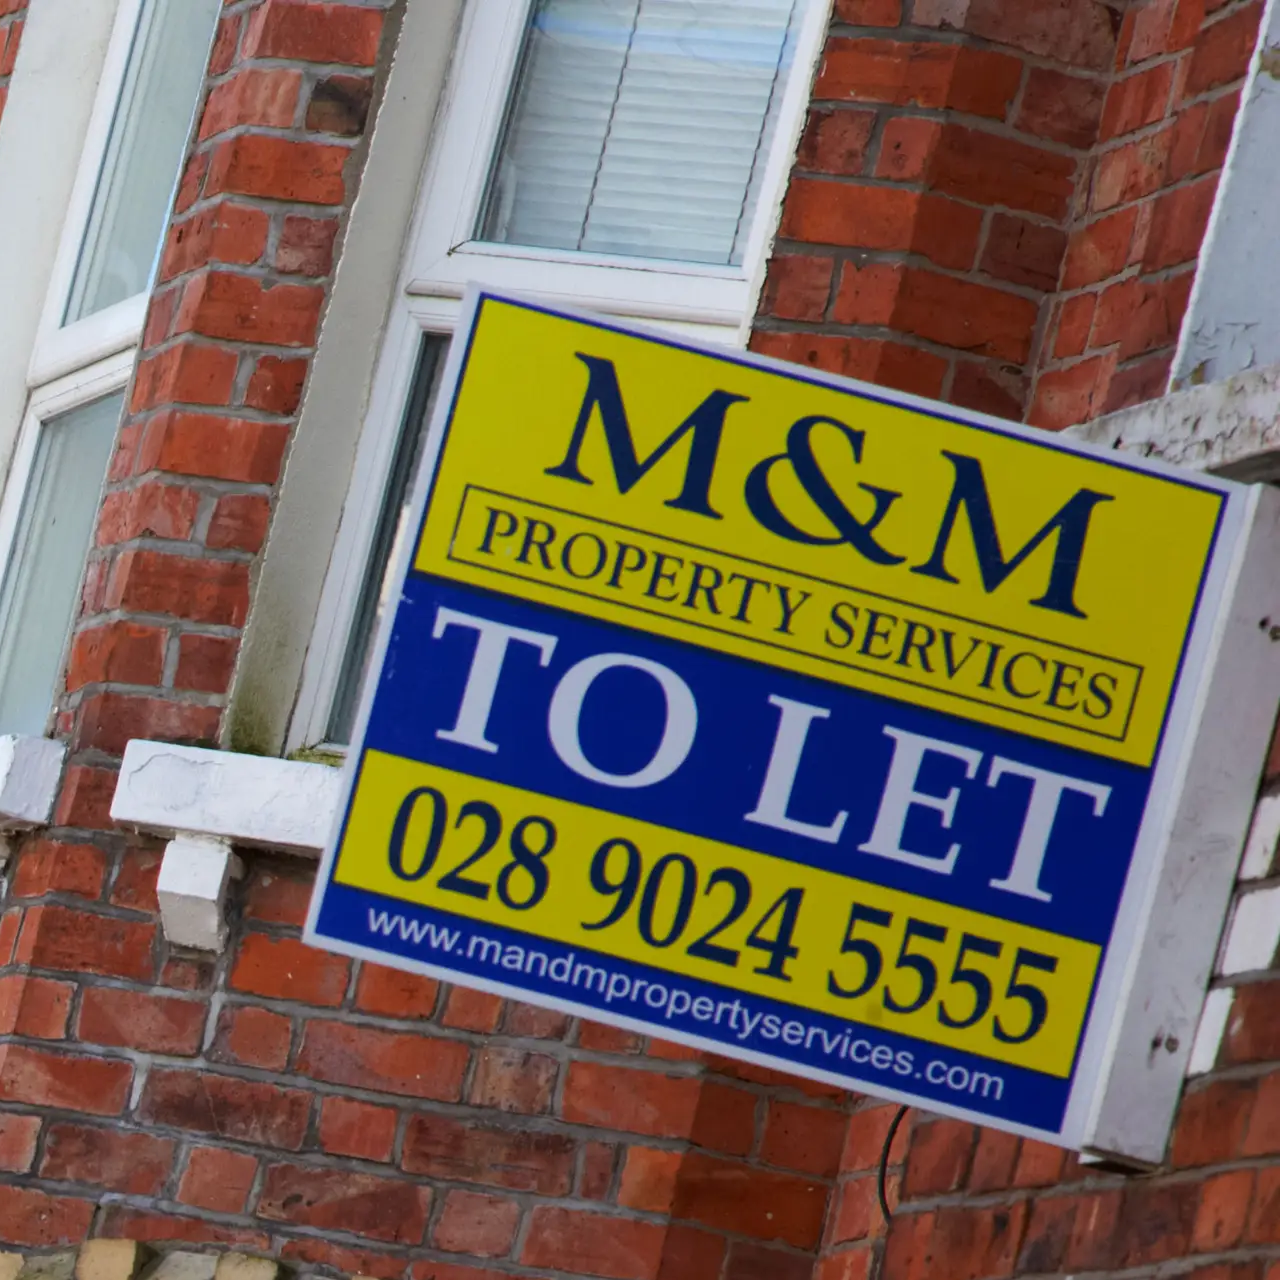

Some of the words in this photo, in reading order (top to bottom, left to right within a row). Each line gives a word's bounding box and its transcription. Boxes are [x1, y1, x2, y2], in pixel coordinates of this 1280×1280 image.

[476, 506, 812, 639] PROPERTY
[824, 601, 1119, 721] SERVICES
[543, 351, 1115, 620] M&M
[432, 606, 699, 789] TO
[744, 693, 1113, 903] LET
[366, 906, 1005, 1102] www.mandmpropertyservices.com
[388, 785, 558, 911] 028
[581, 837, 807, 980] 9024
[827, 903, 1059, 1045] 5555
